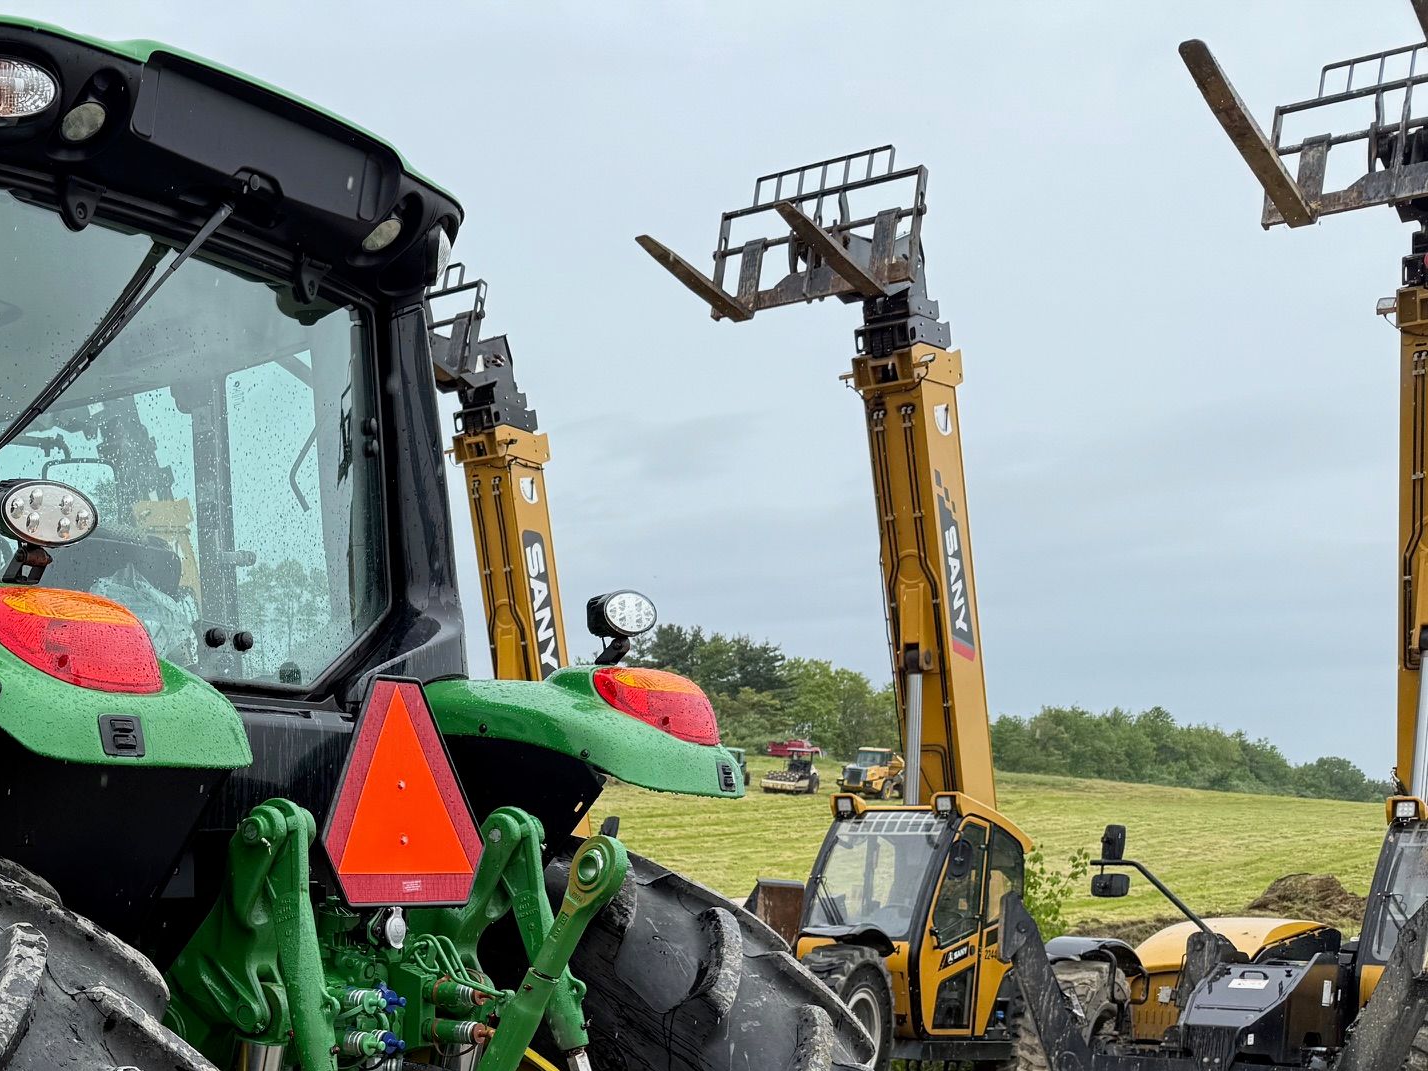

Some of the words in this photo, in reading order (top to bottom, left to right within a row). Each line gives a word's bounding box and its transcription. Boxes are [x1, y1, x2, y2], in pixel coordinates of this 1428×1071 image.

[525, 542, 559, 670] SANY
[945, 525, 968, 633] SANY
[953, 946, 968, 960] SANY
